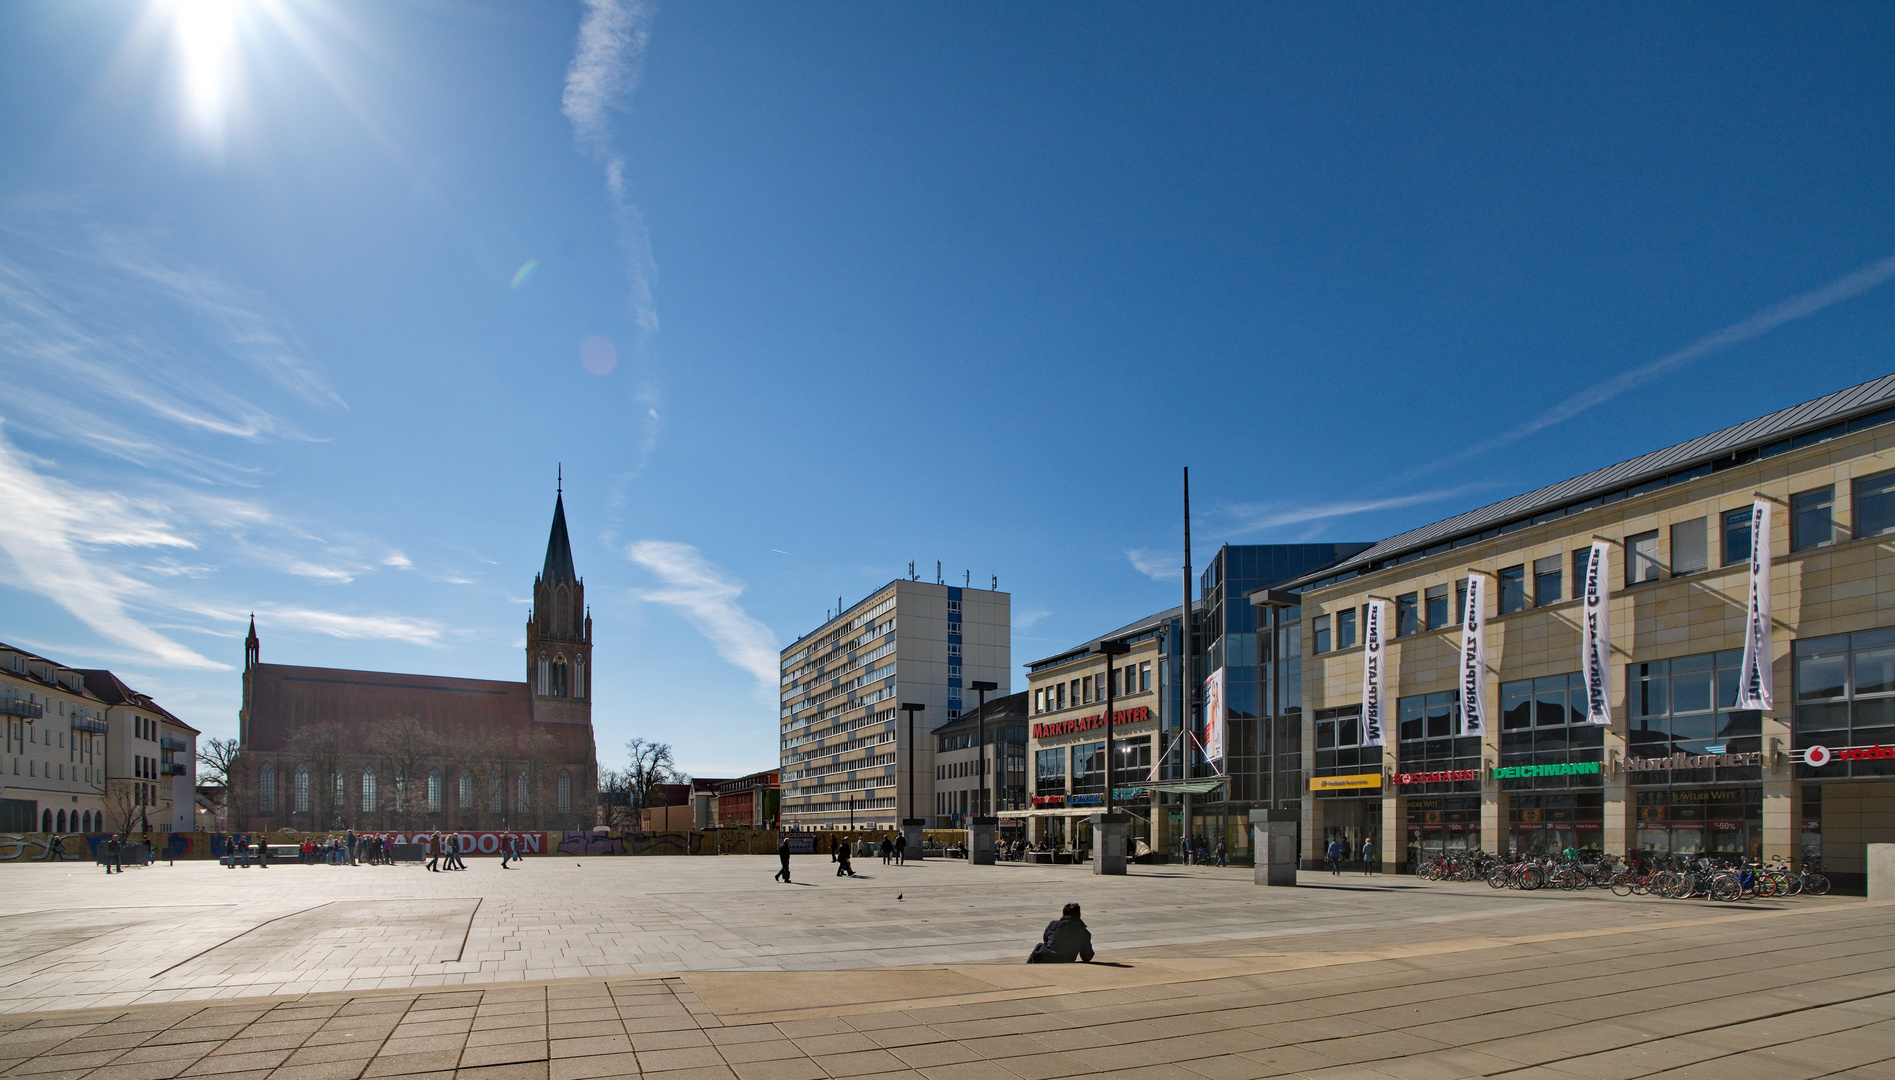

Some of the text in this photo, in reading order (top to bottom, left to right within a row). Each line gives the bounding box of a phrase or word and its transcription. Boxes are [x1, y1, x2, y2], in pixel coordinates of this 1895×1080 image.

[1837, 744, 1895, 761] voda
[1494, 761, 1600, 779] DEICHMANN
[1624, 751, 1754, 772] Nordkurier
[1393, 769, 1474, 785] ROSSMANN
[1673, 792, 1710, 801] JUWELIER
